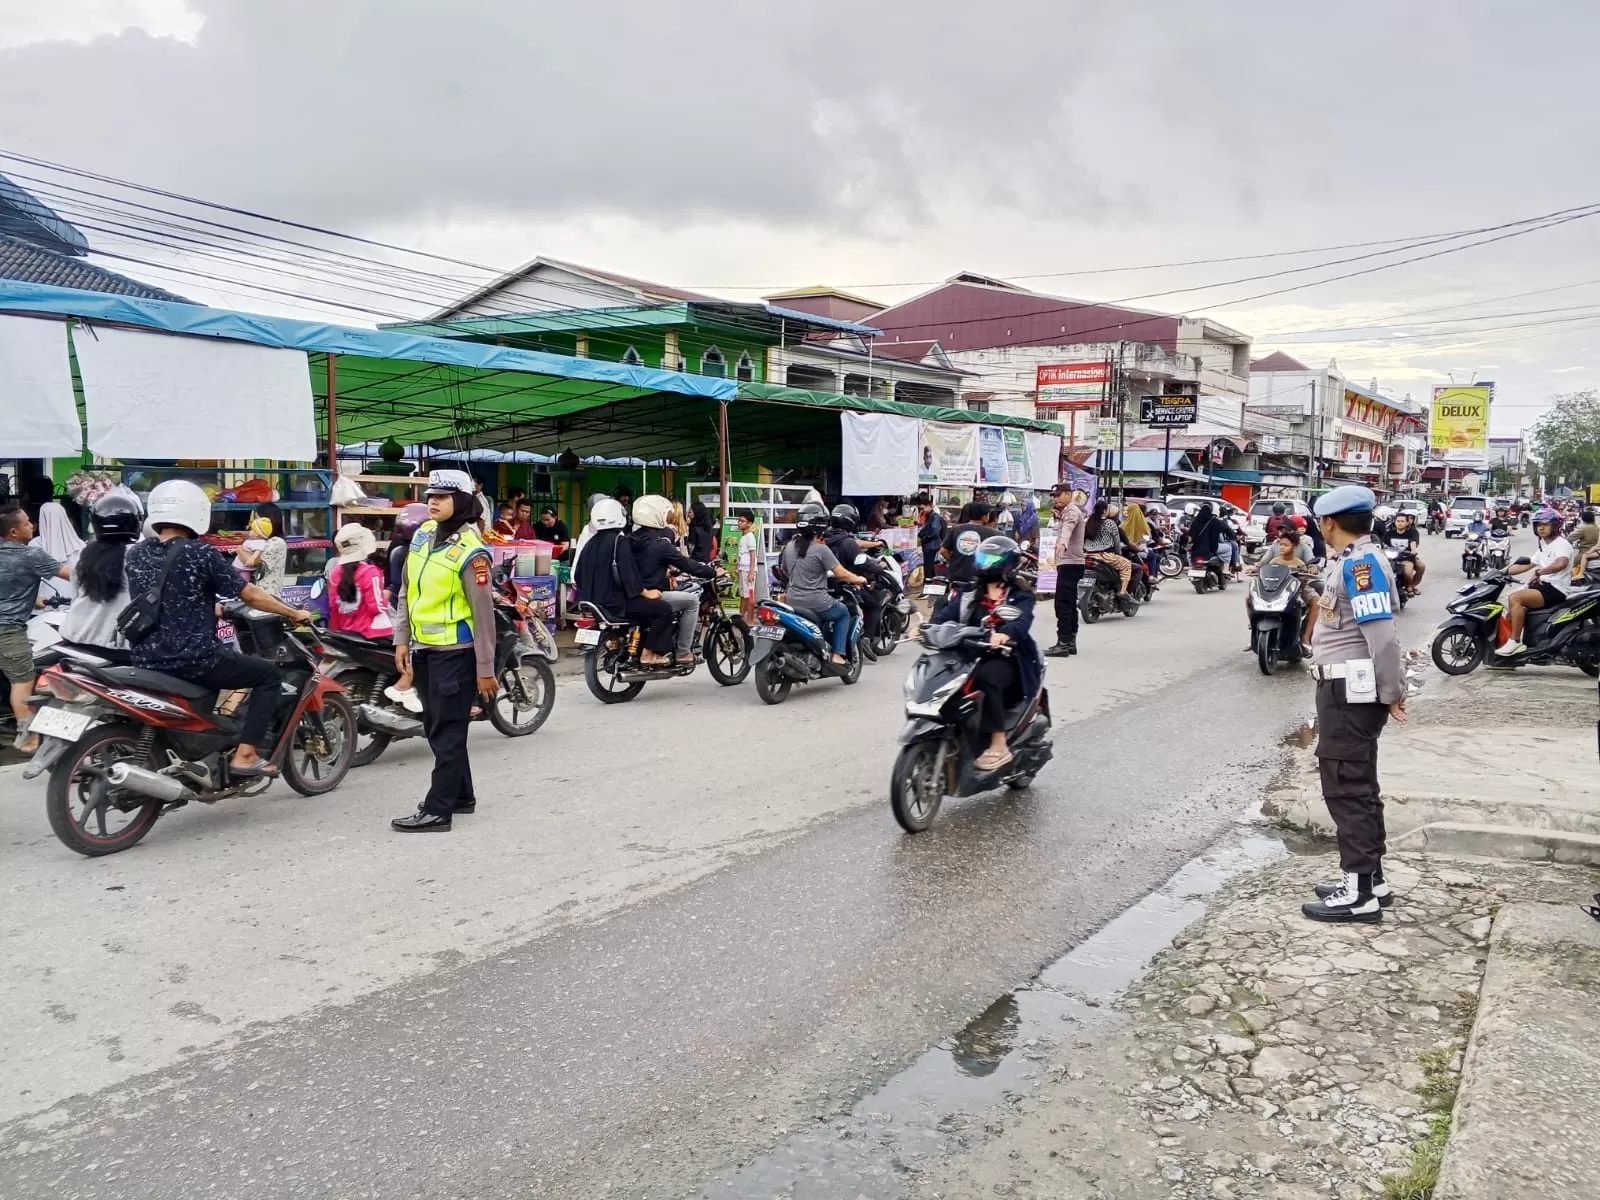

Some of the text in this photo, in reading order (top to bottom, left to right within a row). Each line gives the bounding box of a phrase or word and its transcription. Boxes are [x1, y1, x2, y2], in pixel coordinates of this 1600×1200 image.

[1039, 368, 1058, 381] OPTIK
[1160, 397, 1192, 405] TEGRA
[1155, 406, 1196, 415] SERVICE CENTER
[1442, 405, 1481, 417] DELUX
[1171, 414, 1193, 422] LAPTOP
